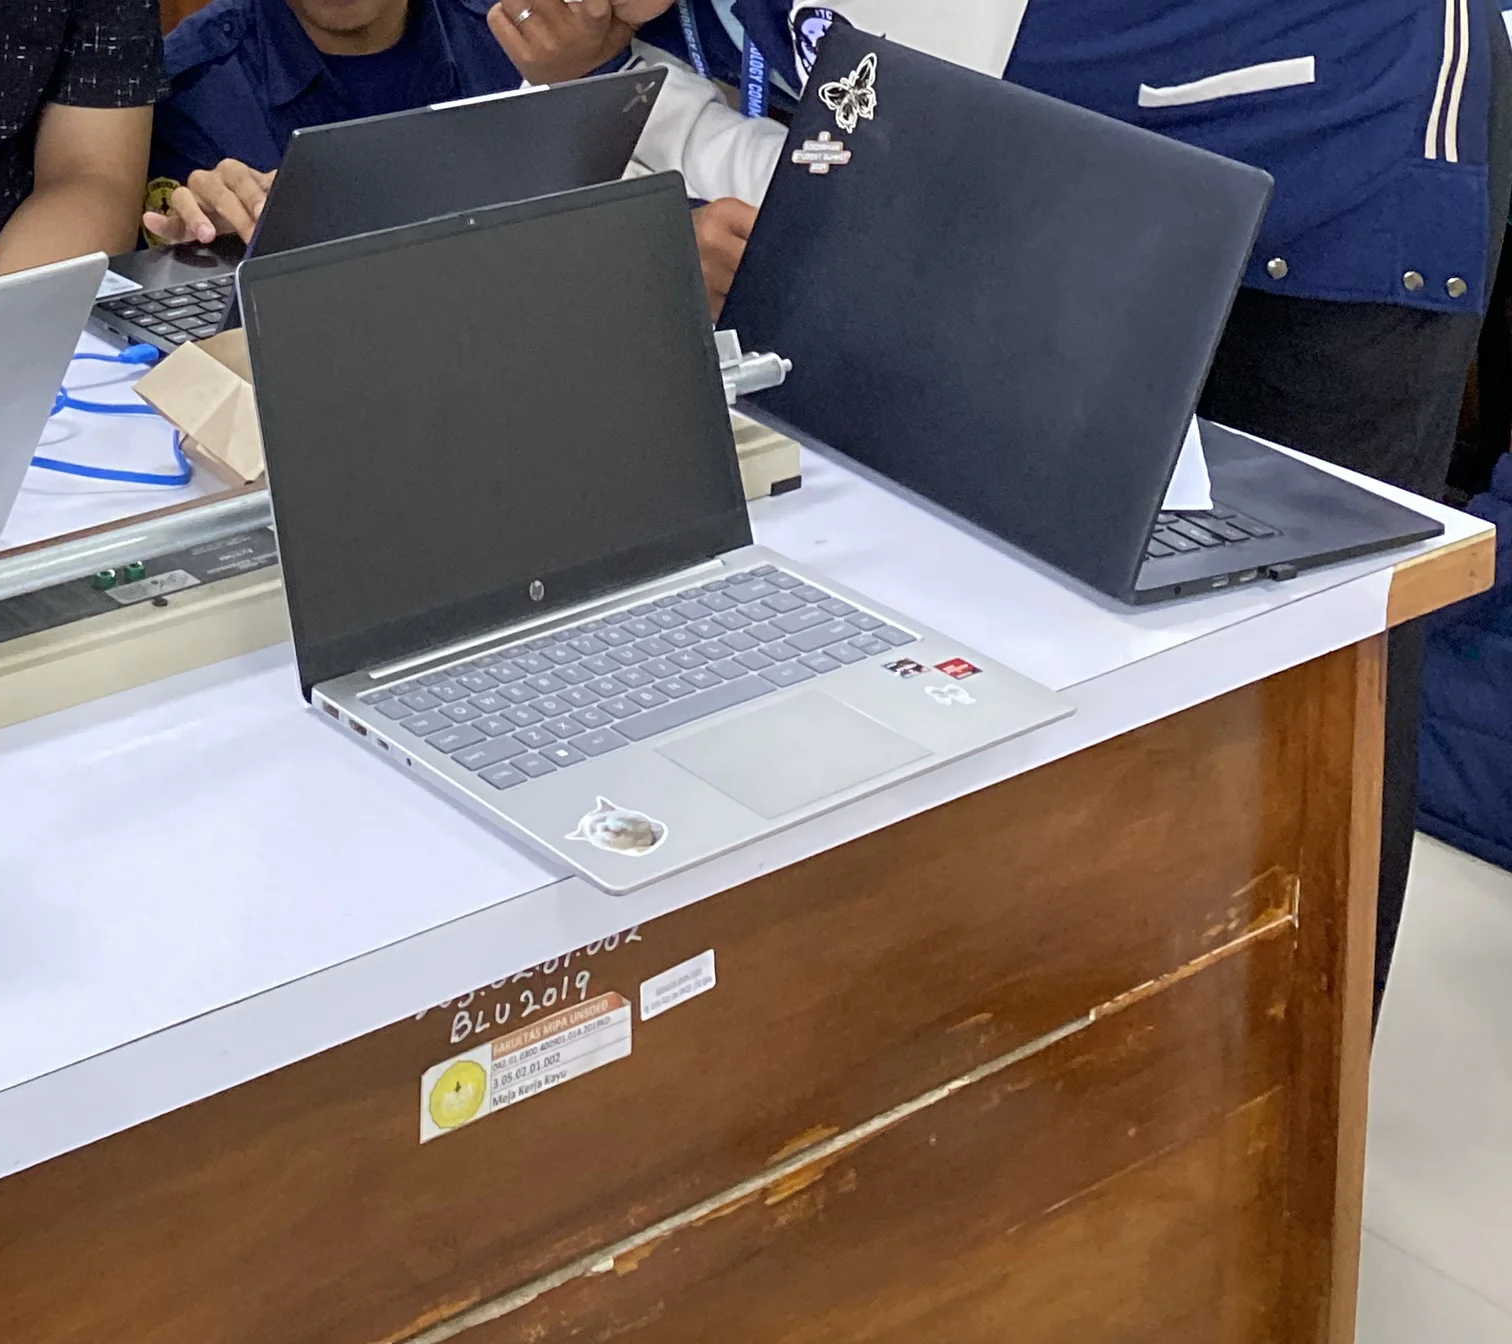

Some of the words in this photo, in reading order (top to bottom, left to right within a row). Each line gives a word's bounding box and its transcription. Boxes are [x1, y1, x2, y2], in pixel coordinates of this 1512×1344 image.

[748, 42, 765, 83] OLOGY
[450, 1002, 511, 1044] BLU
[519, 970, 590, 1017] 2019
[493, 1027, 542, 1056] FAKULTAS
[543, 1015, 569, 1036] MIPA
[570, 999, 609, 1026] UNSOED
[492, 1091, 516, 1108] Meja
[518, 1077, 543, 1096] Kerja
